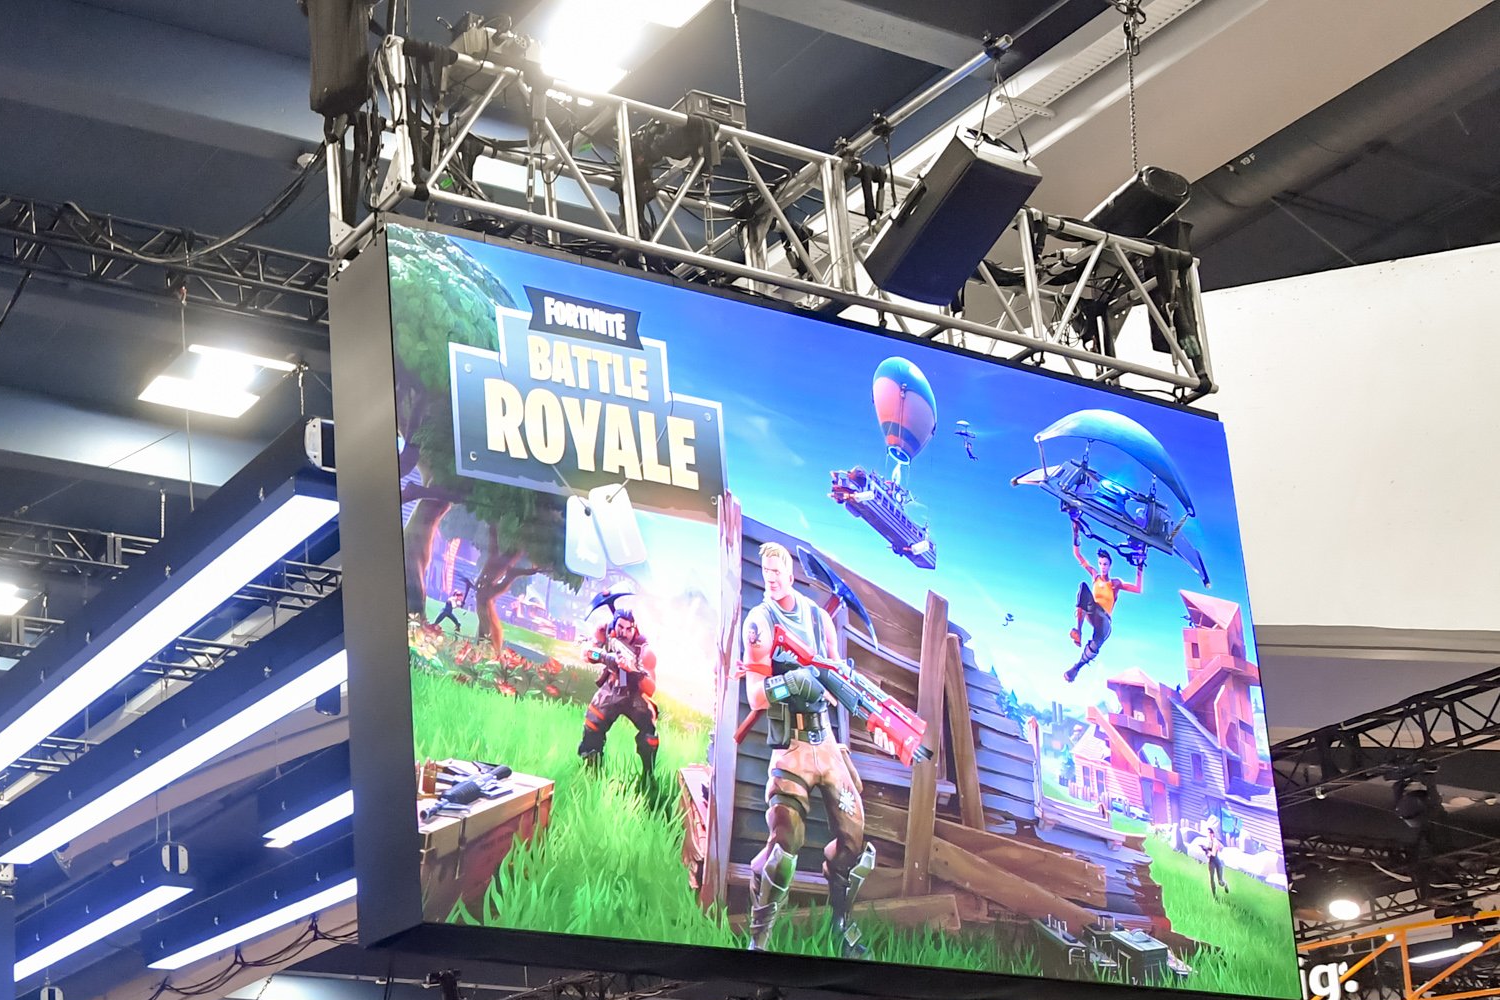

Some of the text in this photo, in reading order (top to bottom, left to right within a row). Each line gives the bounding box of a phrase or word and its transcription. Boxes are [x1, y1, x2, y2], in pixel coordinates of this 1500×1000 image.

[544, 296, 626, 341] FORTNITE
[527, 335, 649, 402] BATTLE
[484, 377, 700, 491] ROYALE
